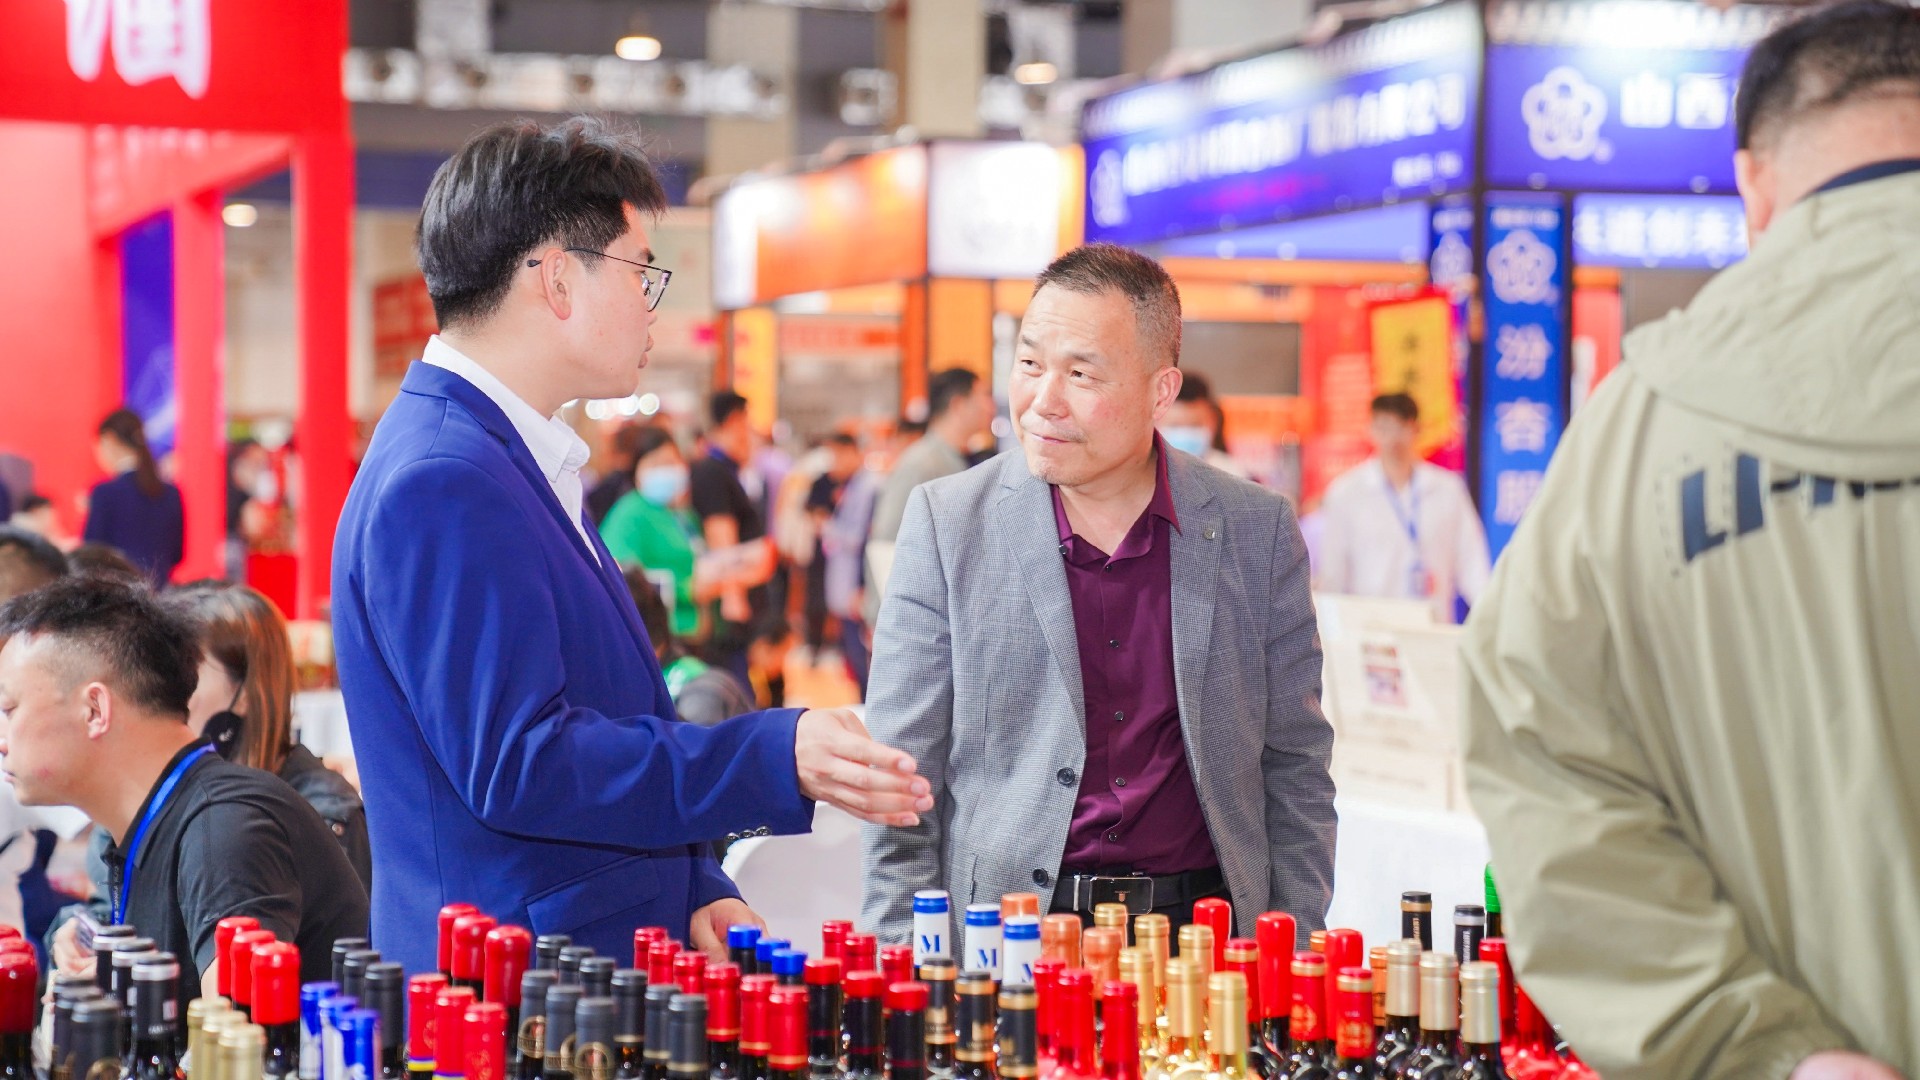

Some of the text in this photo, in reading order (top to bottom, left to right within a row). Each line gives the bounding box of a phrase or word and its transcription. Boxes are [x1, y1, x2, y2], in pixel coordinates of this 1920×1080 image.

[1620, 71, 1738, 129] 山西
[921, 934, 941, 953] M
[977, 948, 997, 968] M
